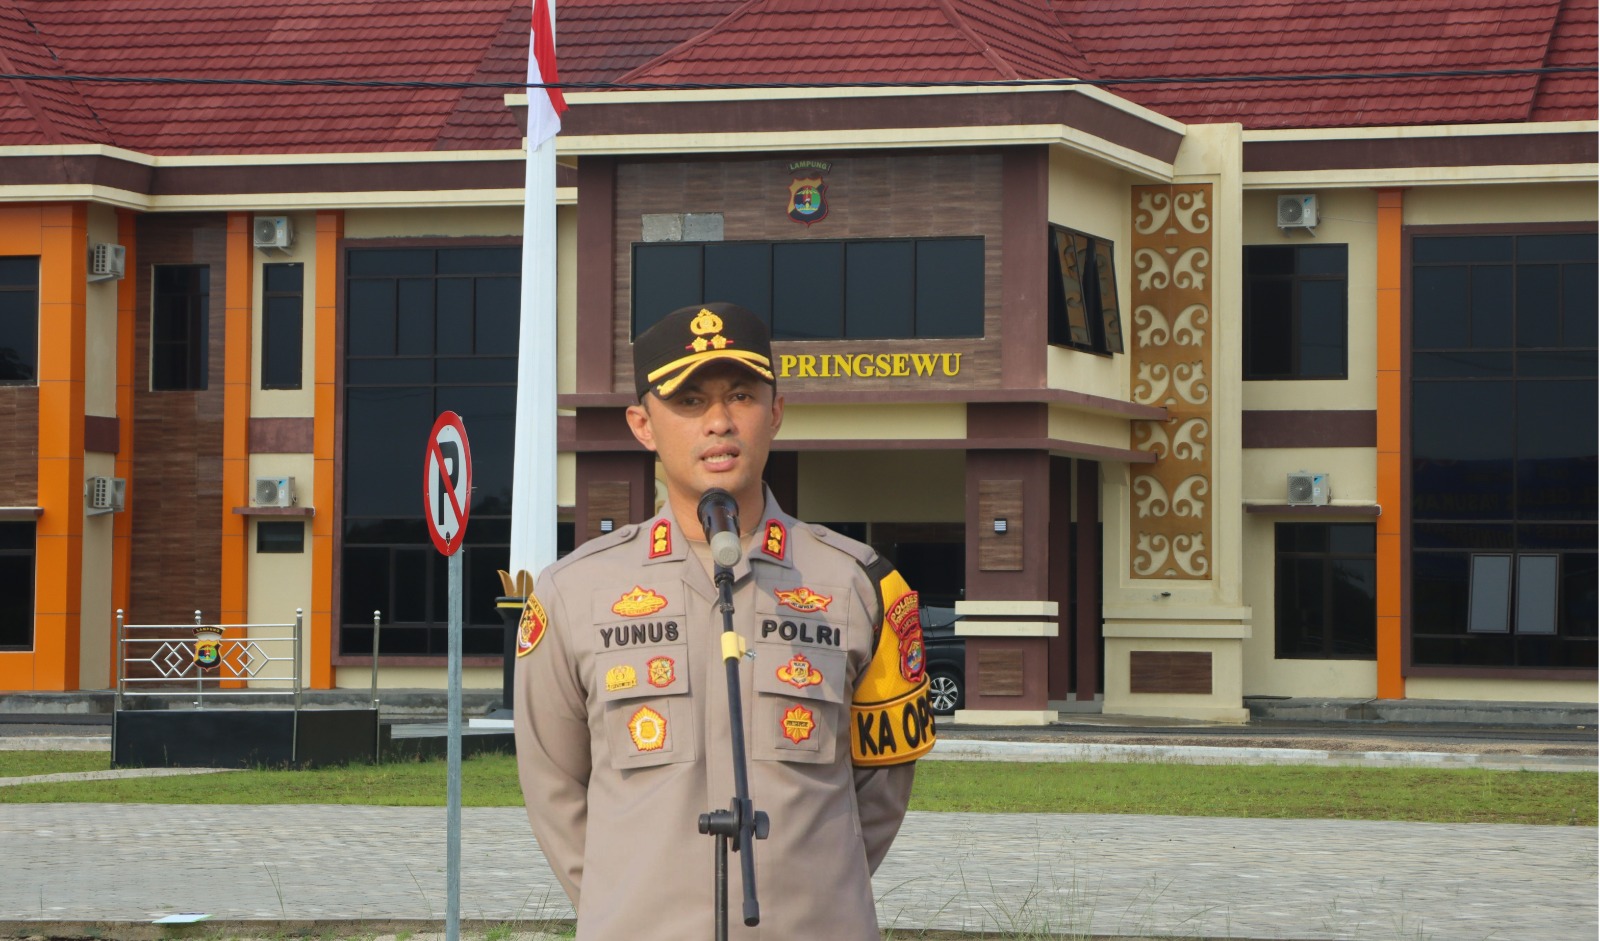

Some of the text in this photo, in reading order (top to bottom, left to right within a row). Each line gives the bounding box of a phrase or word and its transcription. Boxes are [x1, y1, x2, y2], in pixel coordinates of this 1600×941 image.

[790, 160, 827, 170] LAMPUNG
[779, 352, 962, 377] PRINGSEWU
[438, 441, 459, 526] P
[600, 621, 679, 648] YUNUS
[761, 619, 841, 647] POLRI
[857, 689, 936, 757] KA OPS
